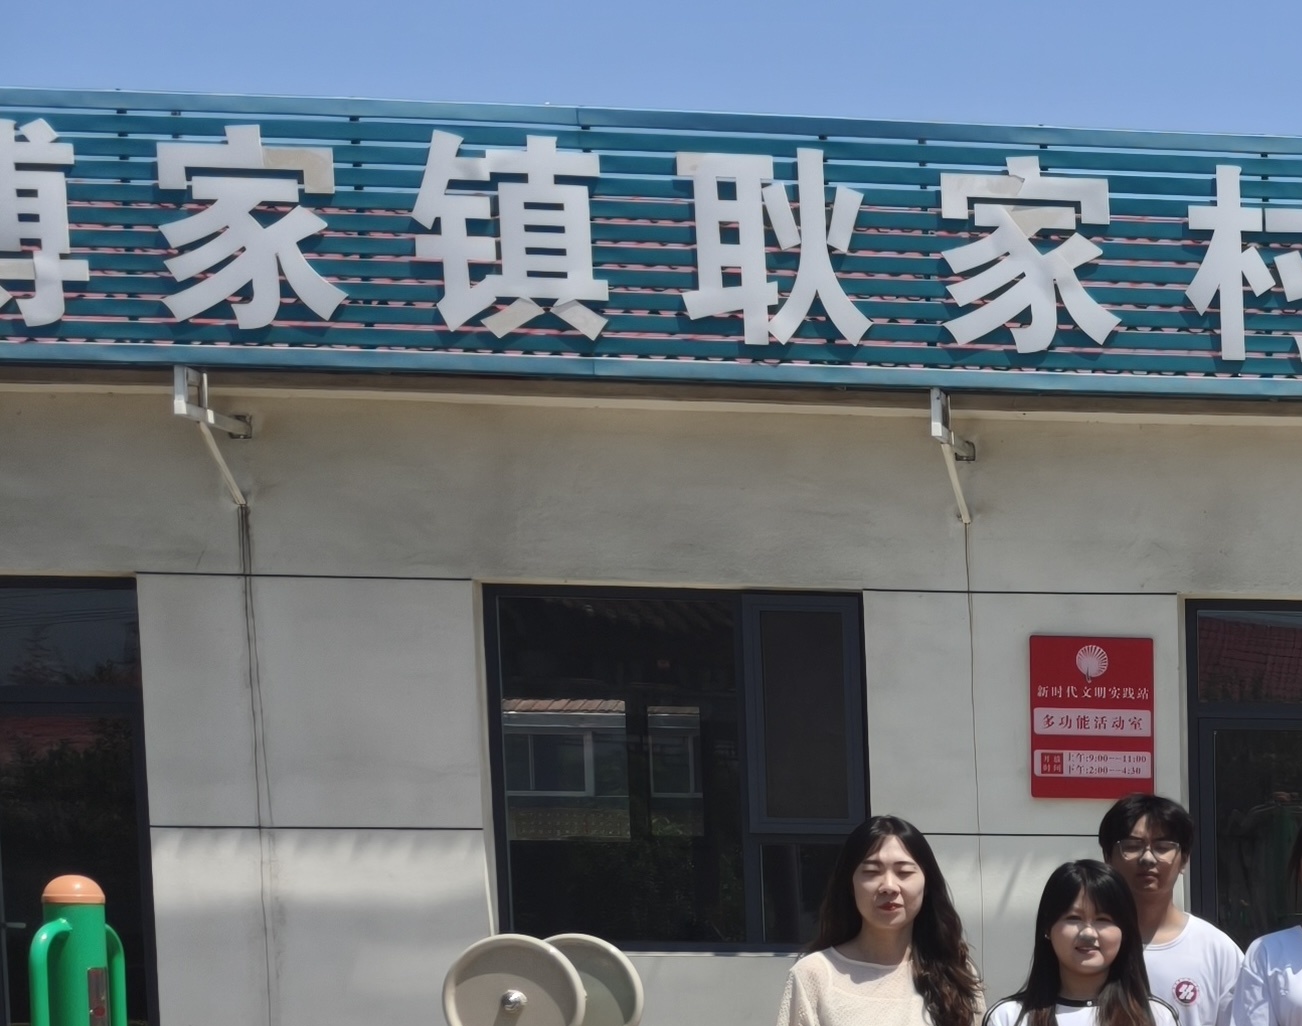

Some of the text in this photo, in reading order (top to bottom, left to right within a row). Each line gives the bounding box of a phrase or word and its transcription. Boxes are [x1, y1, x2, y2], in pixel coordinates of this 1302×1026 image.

[1037, 685, 1149, 700] 新时代文明实践站
[1043, 714, 1143, 731] 多功能活动室
